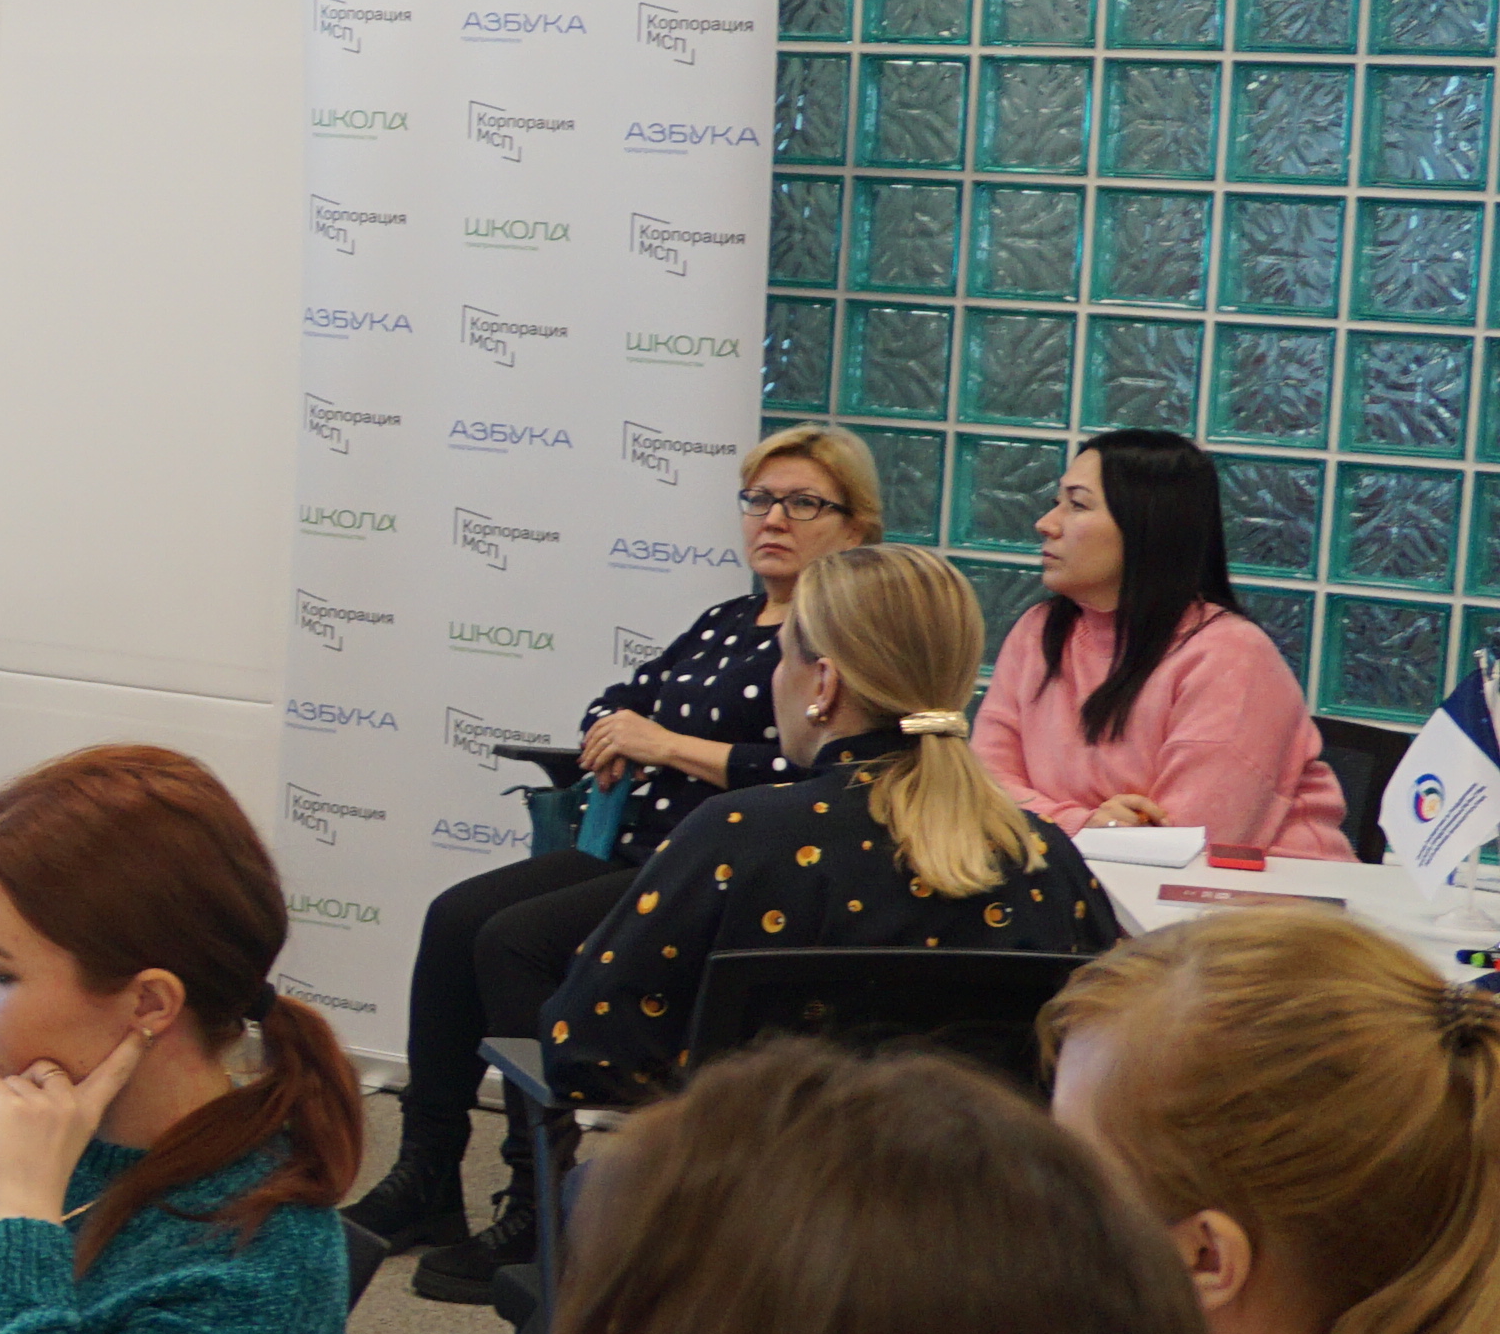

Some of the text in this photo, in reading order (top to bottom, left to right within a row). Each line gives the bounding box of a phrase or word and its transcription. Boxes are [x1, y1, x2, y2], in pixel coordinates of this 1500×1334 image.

[320, 4, 412, 23] Корпорация
[461, 11, 587, 34] АЗБУКА
[646, 14, 754, 34] Корпорация
[320, 22, 355, 42] МСП
[646, 33, 687, 54] МСП
[312, 107, 409, 131] ШКОЛА
[476, 112, 575, 132] Корпорация
[476, 130, 514, 151] МСП
[624, 122, 760, 147] АЗБУКА
[315, 204, 407, 226] Корпорация
[315, 222, 349, 244] МСП
[464, 216, 571, 242] ШКОЛА
[638, 224, 746, 246] Корпорация
[638, 244, 679, 265] МСП
[303, 307, 413, 334] АЗБУКА
[469, 317, 569, 338] Корпорация
[469, 334, 508, 357] МСП
[626, 331, 741, 359] ШКОЛА
[308, 404, 401, 427] Корпорация
[308, 420, 343, 444] МСП
[449, 419, 574, 449] АЗБУКА
[631, 432, 737, 456] Корпорация
[631, 450, 670, 474] МСП
[301, 503, 397, 533] ШКОЛА
[462, 519, 561, 543] Корпорация
[462, 534, 500, 560] МСП
[609, 538, 743, 568] АЗБУКА
[301, 601, 395, 625] Корпорация
[301, 616, 336, 640] МСП
[448, 620, 556, 651] ШКОЛА
[286, 698, 399, 731] АЗБУКА
[453, 717, 552, 745] Корпорация
[453, 732, 491, 756] МСП
[291, 794, 387, 821] Корпорация
[291, 810, 329, 835] МСП
